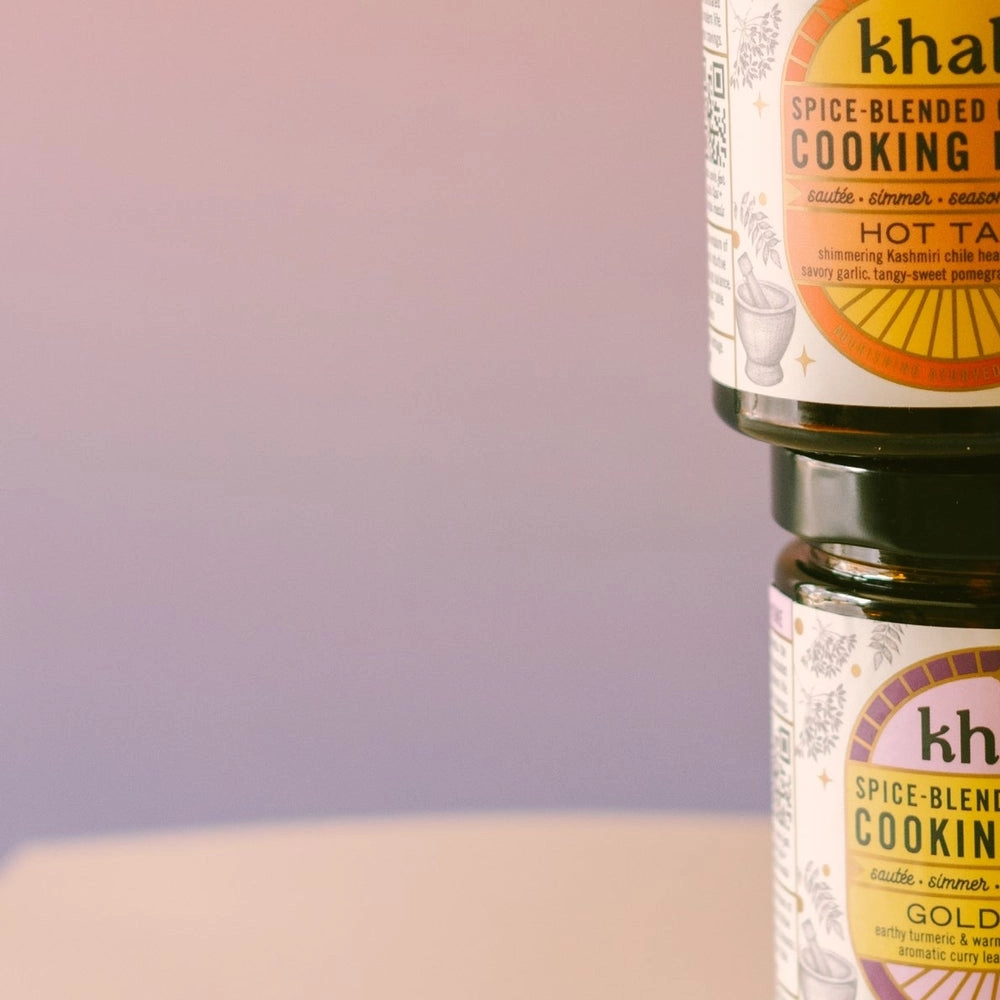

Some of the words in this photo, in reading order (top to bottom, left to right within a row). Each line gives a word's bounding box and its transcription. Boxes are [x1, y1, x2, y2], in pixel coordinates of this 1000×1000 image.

[791, 96, 986, 123] SPICE-BLENDED
[791, 128, 969, 172] COOKING
[807, 186, 854, 205] sautée
[868, 189, 932, 206] simmer
[861, 222, 935, 244] HOT
[818, 248, 883, 265] shimmering
[887, 249, 940, 262] Kashmiri
[944, 249, 974, 263] chile
[801, 265, 833, 280] savory
[873, 267, 946, 283] tangy-sweet
[870, 867, 915, 885] sautée
[928, 874, 989, 891] simmer
[906, 902, 1000, 930] GOLD
[875, 925, 906, 942] earthy
[909, 930, 955, 945] turmeric
[960, 933, 968, 946] &
[898, 946, 946, 961] aromatic
[950, 950, 978, 965] curry
